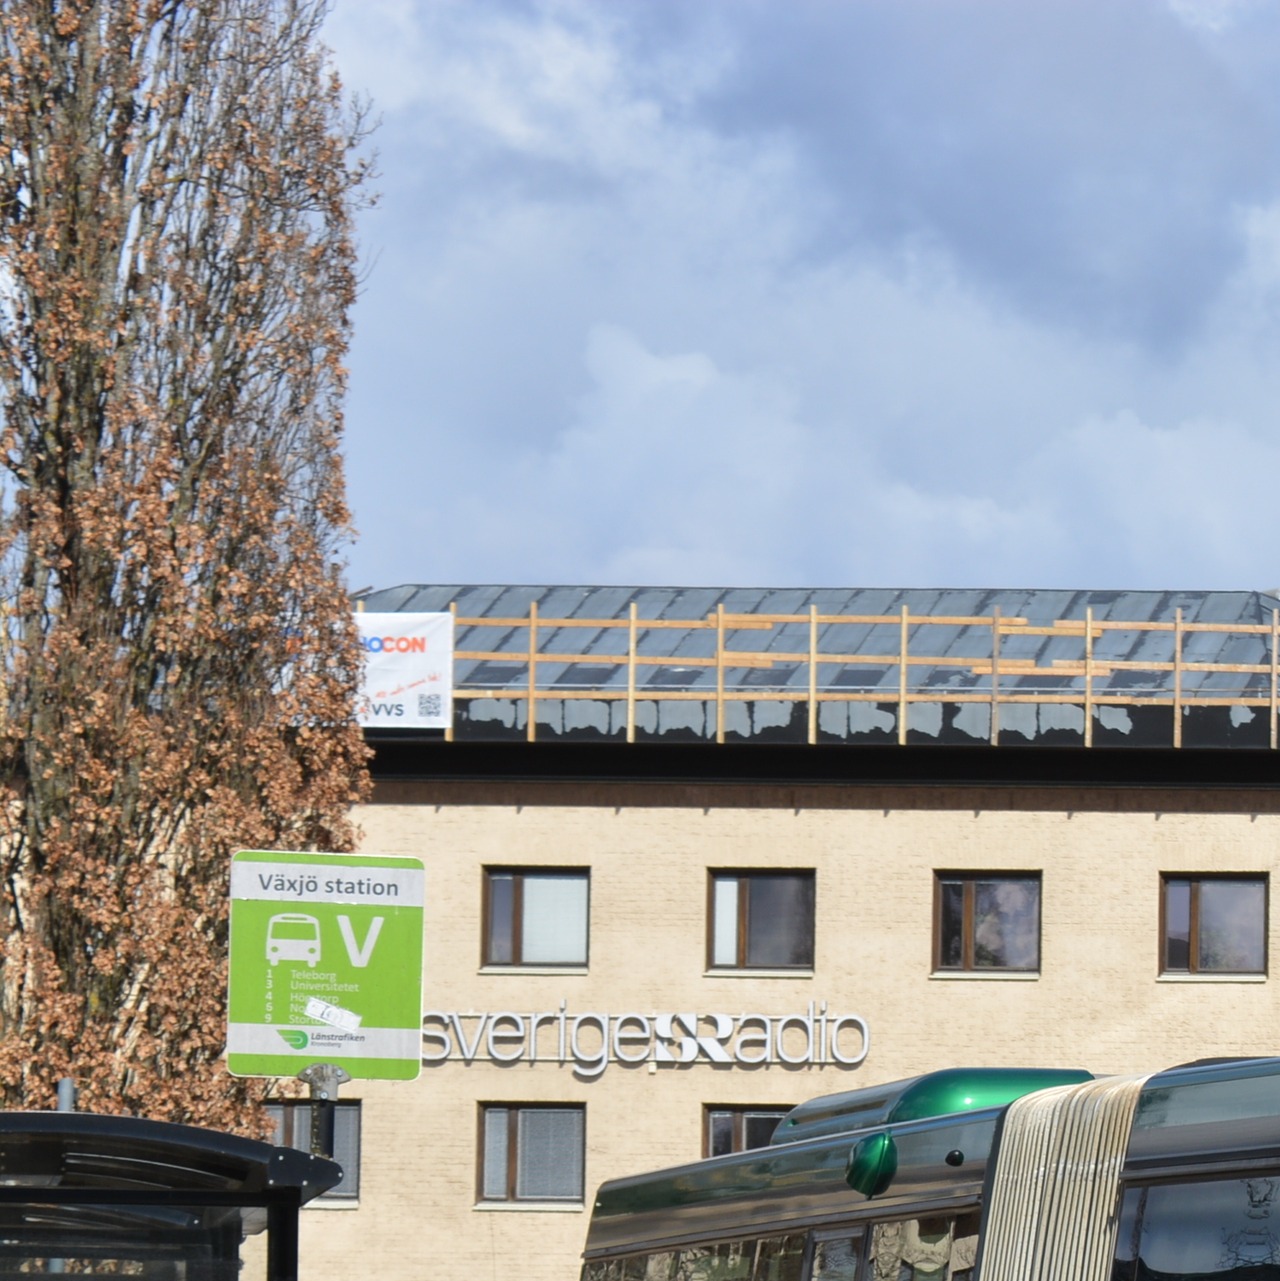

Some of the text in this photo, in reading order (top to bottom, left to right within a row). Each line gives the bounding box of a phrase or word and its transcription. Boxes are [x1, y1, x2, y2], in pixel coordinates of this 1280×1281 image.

[371, 703, 404, 717] VVS
[258, 873, 399, 896] Växjö station
[336, 915, 385, 968] V
[266, 969, 336, 983] 1 Teleborg
[266, 979, 360, 992] 3 Universitetet
[265, 991, 273, 1000] 4
[265, 1002, 273, 1012] 6
[264, 1013, 272, 1023] 9
[311, 1032, 365, 1042] Länstrafiken
